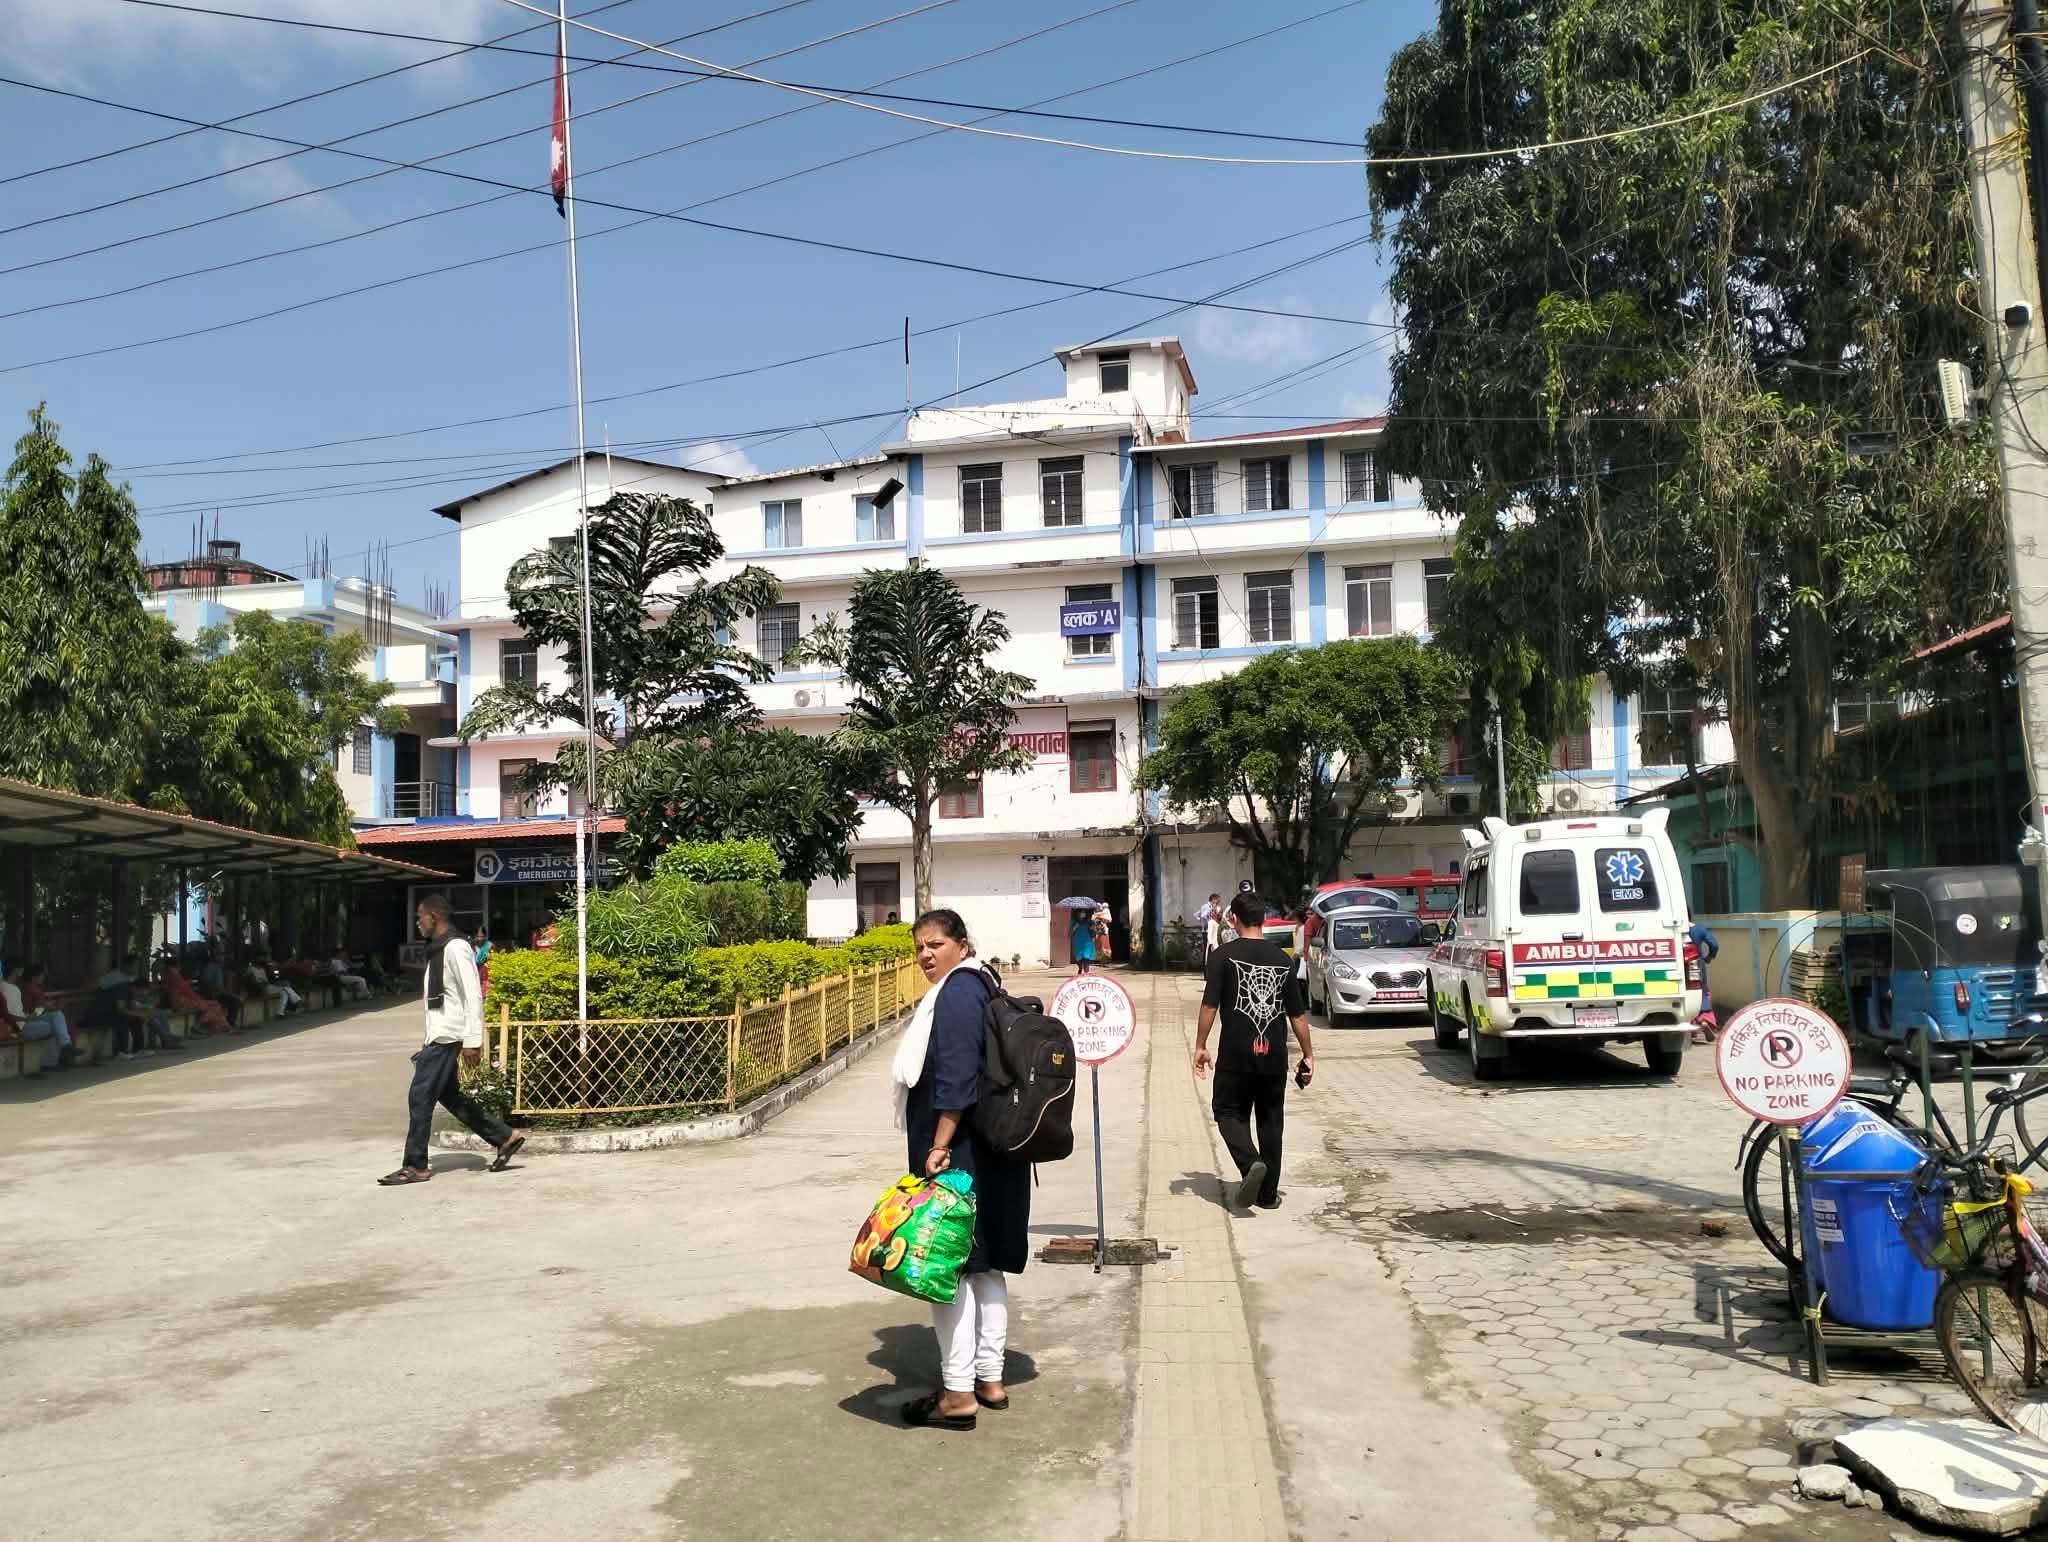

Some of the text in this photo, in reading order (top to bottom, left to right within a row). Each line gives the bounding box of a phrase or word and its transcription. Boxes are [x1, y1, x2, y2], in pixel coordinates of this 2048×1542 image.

[518, 869, 567, 880] EMERGENCY
[1612, 887, 1645, 900] EMS
[1525, 941, 1671, 961] AMBULANCE
[1077, 1025, 1127, 1039] PARKING
[1077, 1041, 1108, 1054] ZONE
[1735, 1072, 1835, 1092] NO PARKING
[1766, 1093, 1809, 1110] ZONE
